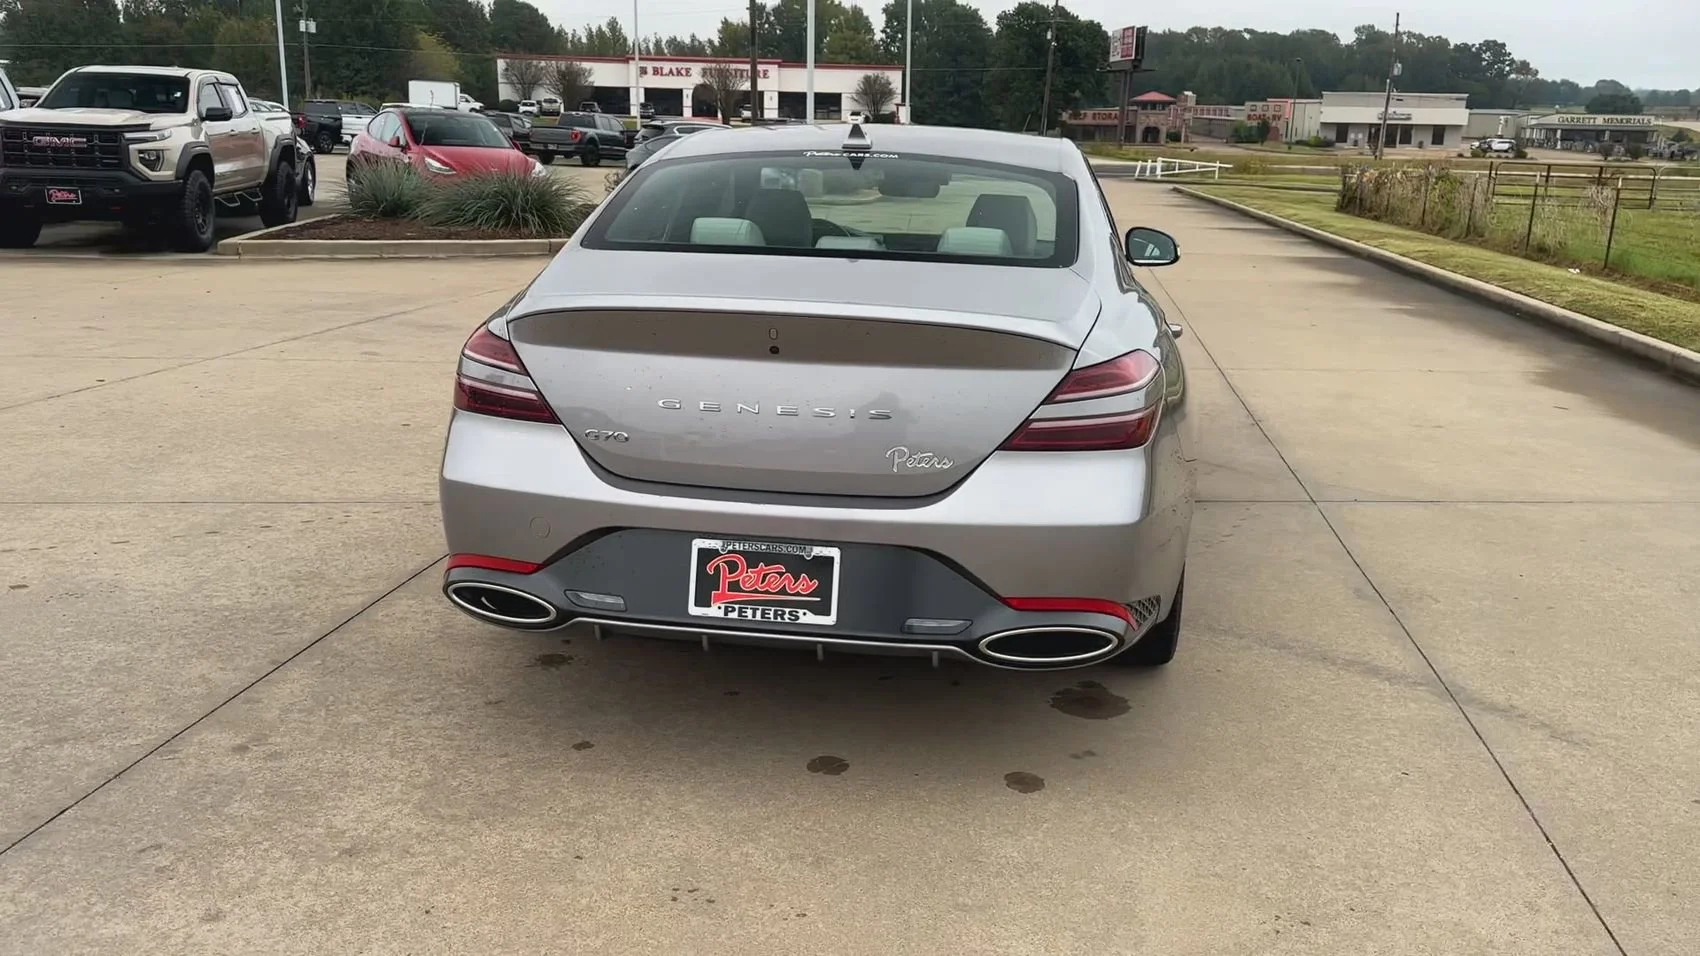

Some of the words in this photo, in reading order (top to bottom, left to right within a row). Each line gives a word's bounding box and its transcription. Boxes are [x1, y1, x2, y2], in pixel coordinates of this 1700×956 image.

[652, 66, 692, 77] BLAKE
[1557, 116, 1597, 124] GARRETT
[1602, 117, 1652, 125] MEMORIALS
[32, 136, 87, 148] GMC
[657, 398, 894, 420] GENESIS
[584, 428, 630, 443] G70
[885, 446, 954, 473] Peters
[707, 554, 819, 602] Peters
[723, 605, 801, 622] PETERS
